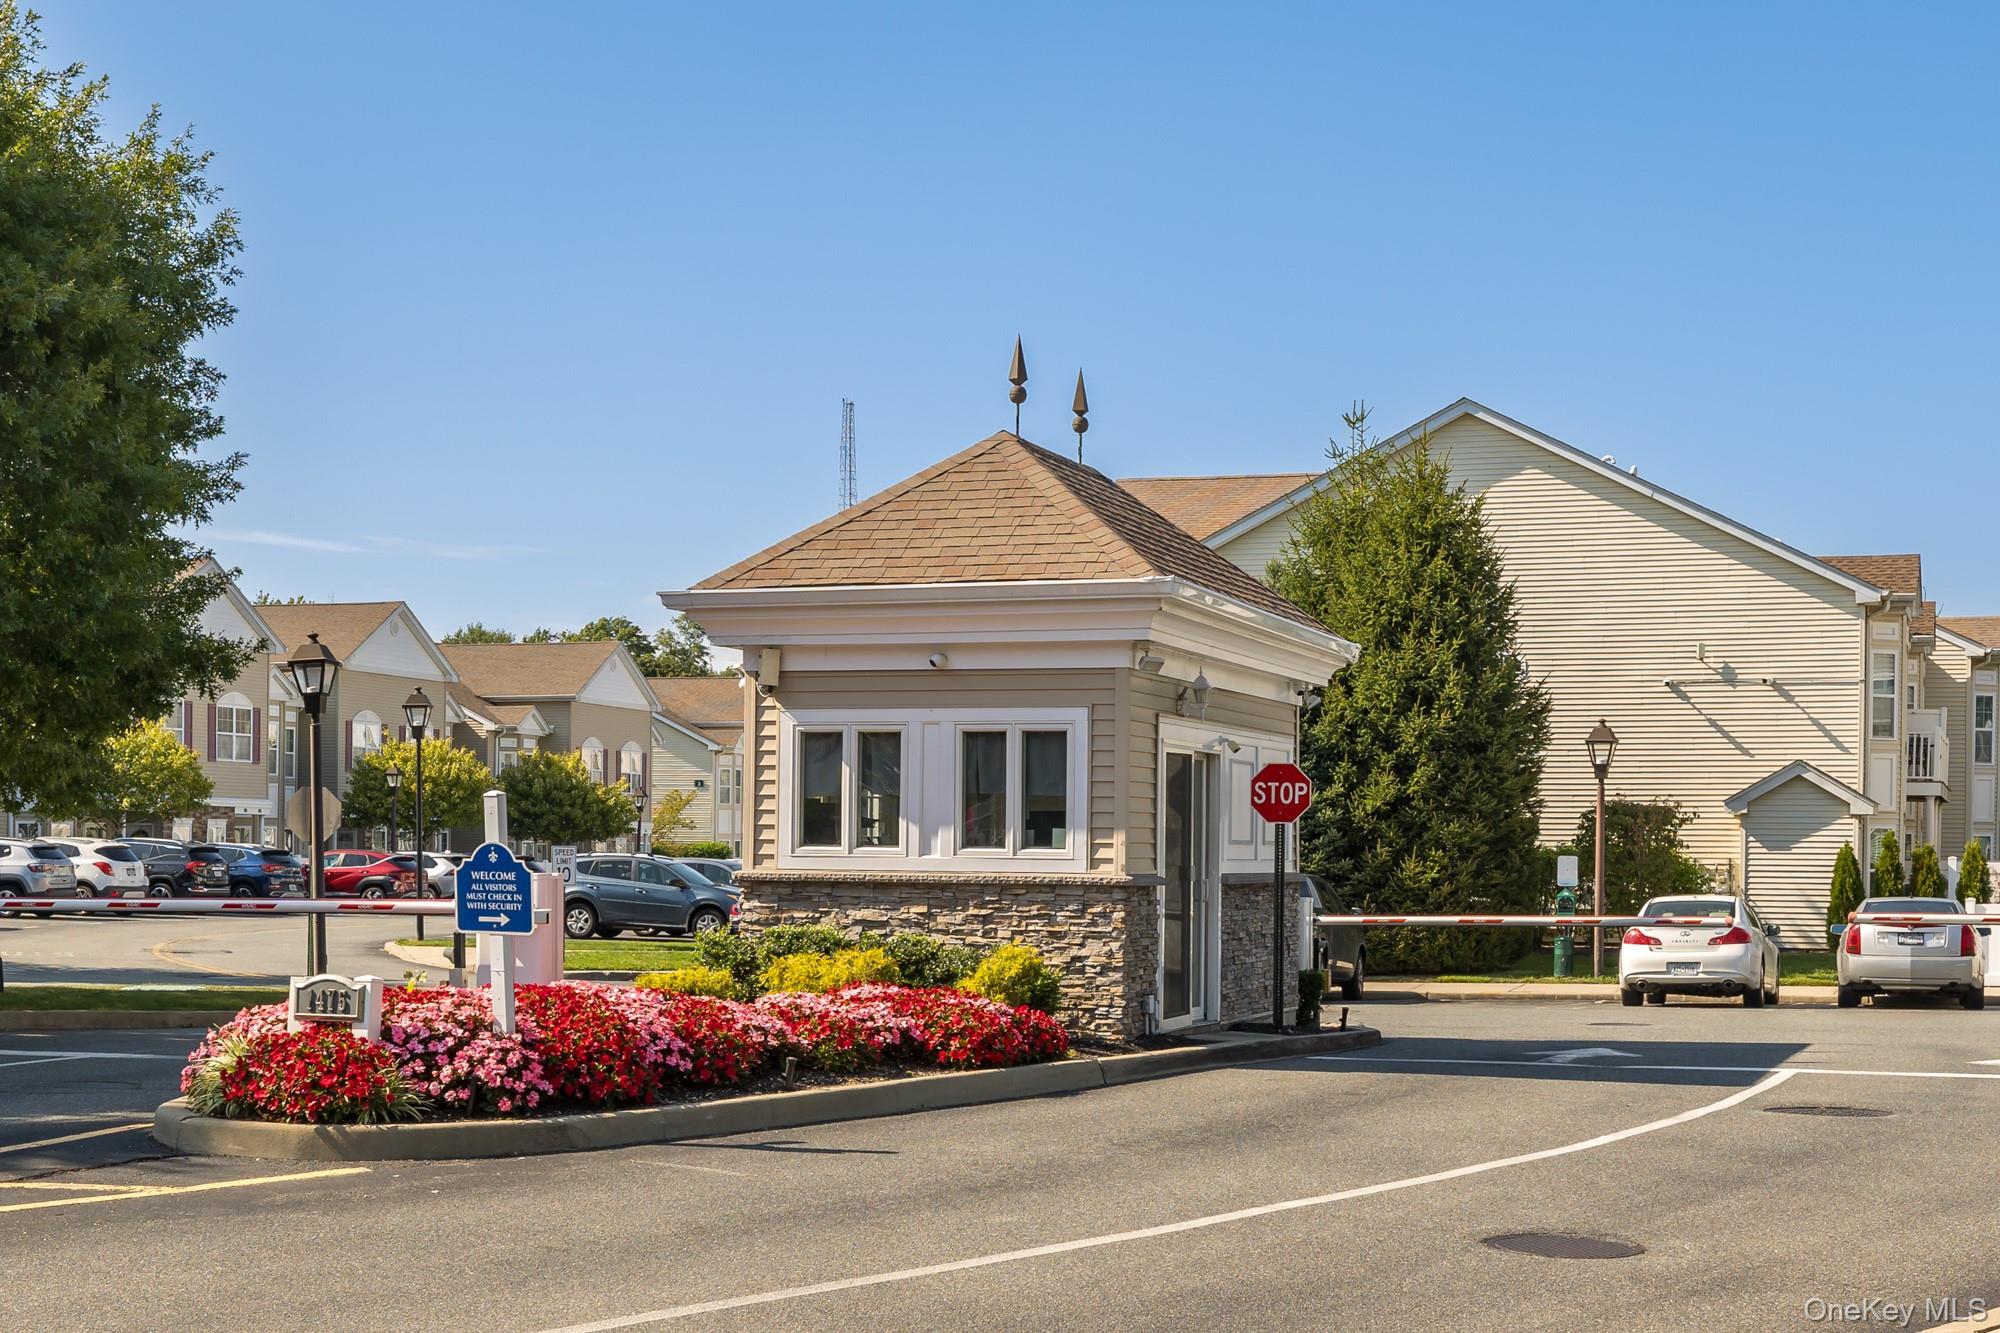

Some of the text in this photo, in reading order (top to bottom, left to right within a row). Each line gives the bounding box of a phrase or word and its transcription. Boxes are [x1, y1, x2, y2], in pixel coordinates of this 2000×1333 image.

[1253, 781, 1308, 805] STOP
[471, 871, 517, 881] WELCOME
[471, 883, 517, 892] ALL VISITORS
[487, 893, 513, 901] CHECK
[467, 902, 522, 911] WITH SECURITY
